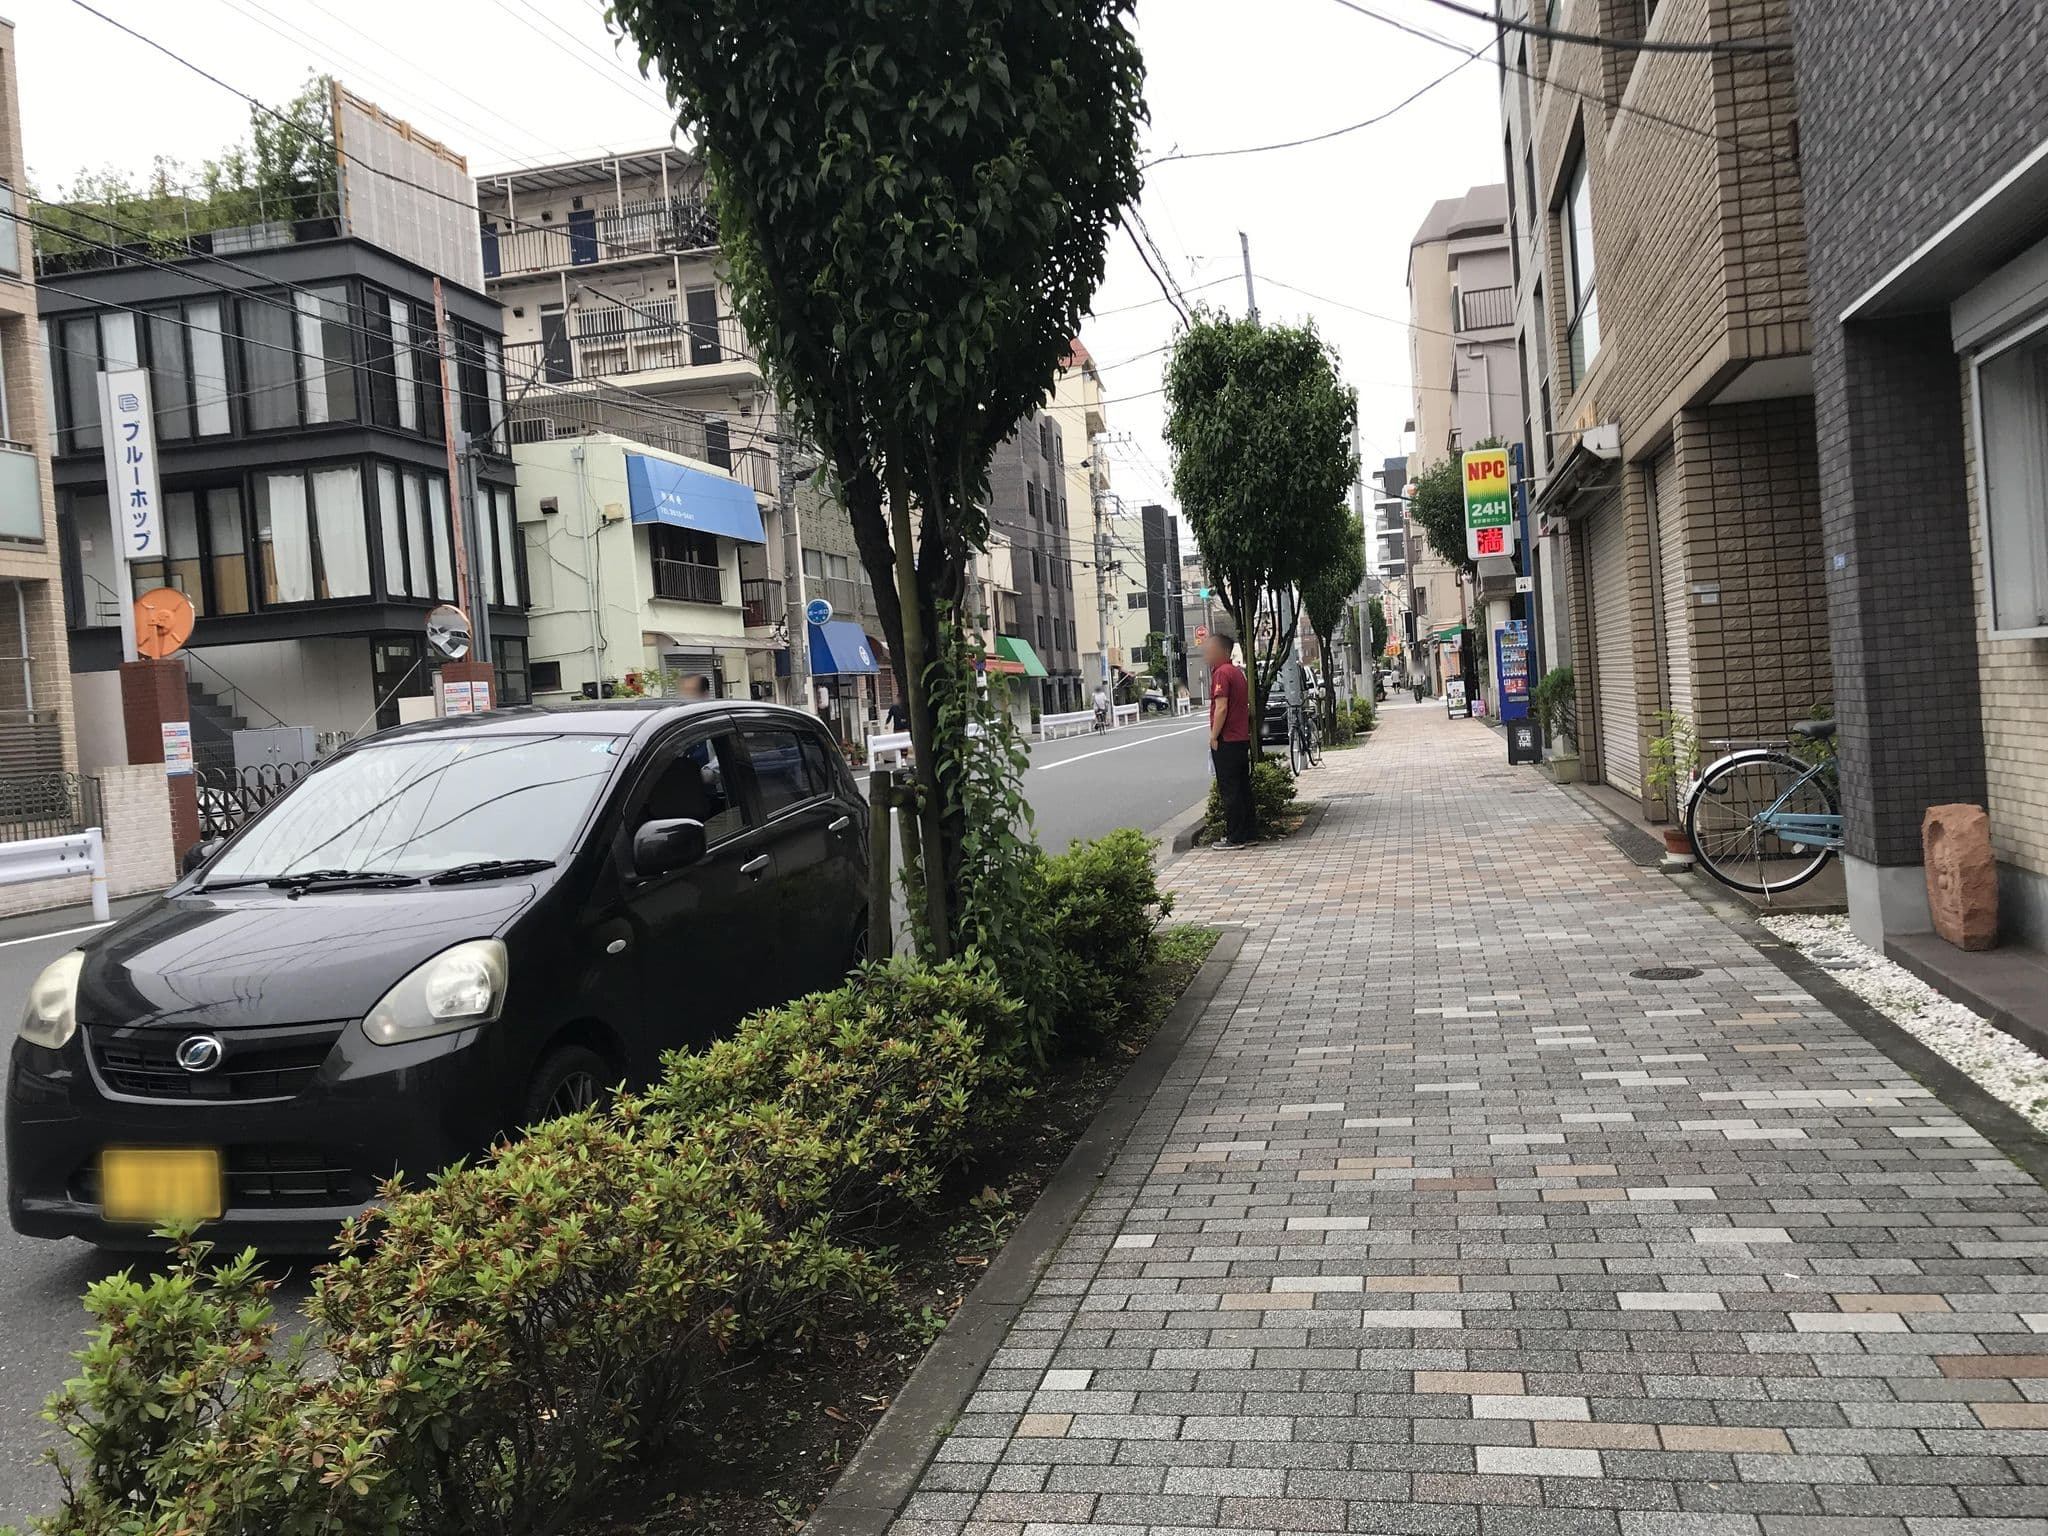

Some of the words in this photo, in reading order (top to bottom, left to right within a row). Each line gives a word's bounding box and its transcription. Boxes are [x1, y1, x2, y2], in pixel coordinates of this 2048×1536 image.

[1467, 460, 1505, 481] NPC
[122, 420, 151, 551] ブルーホップ
[1471, 501, 1506, 517] 24H
[1477, 527, 1505, 554] 満
